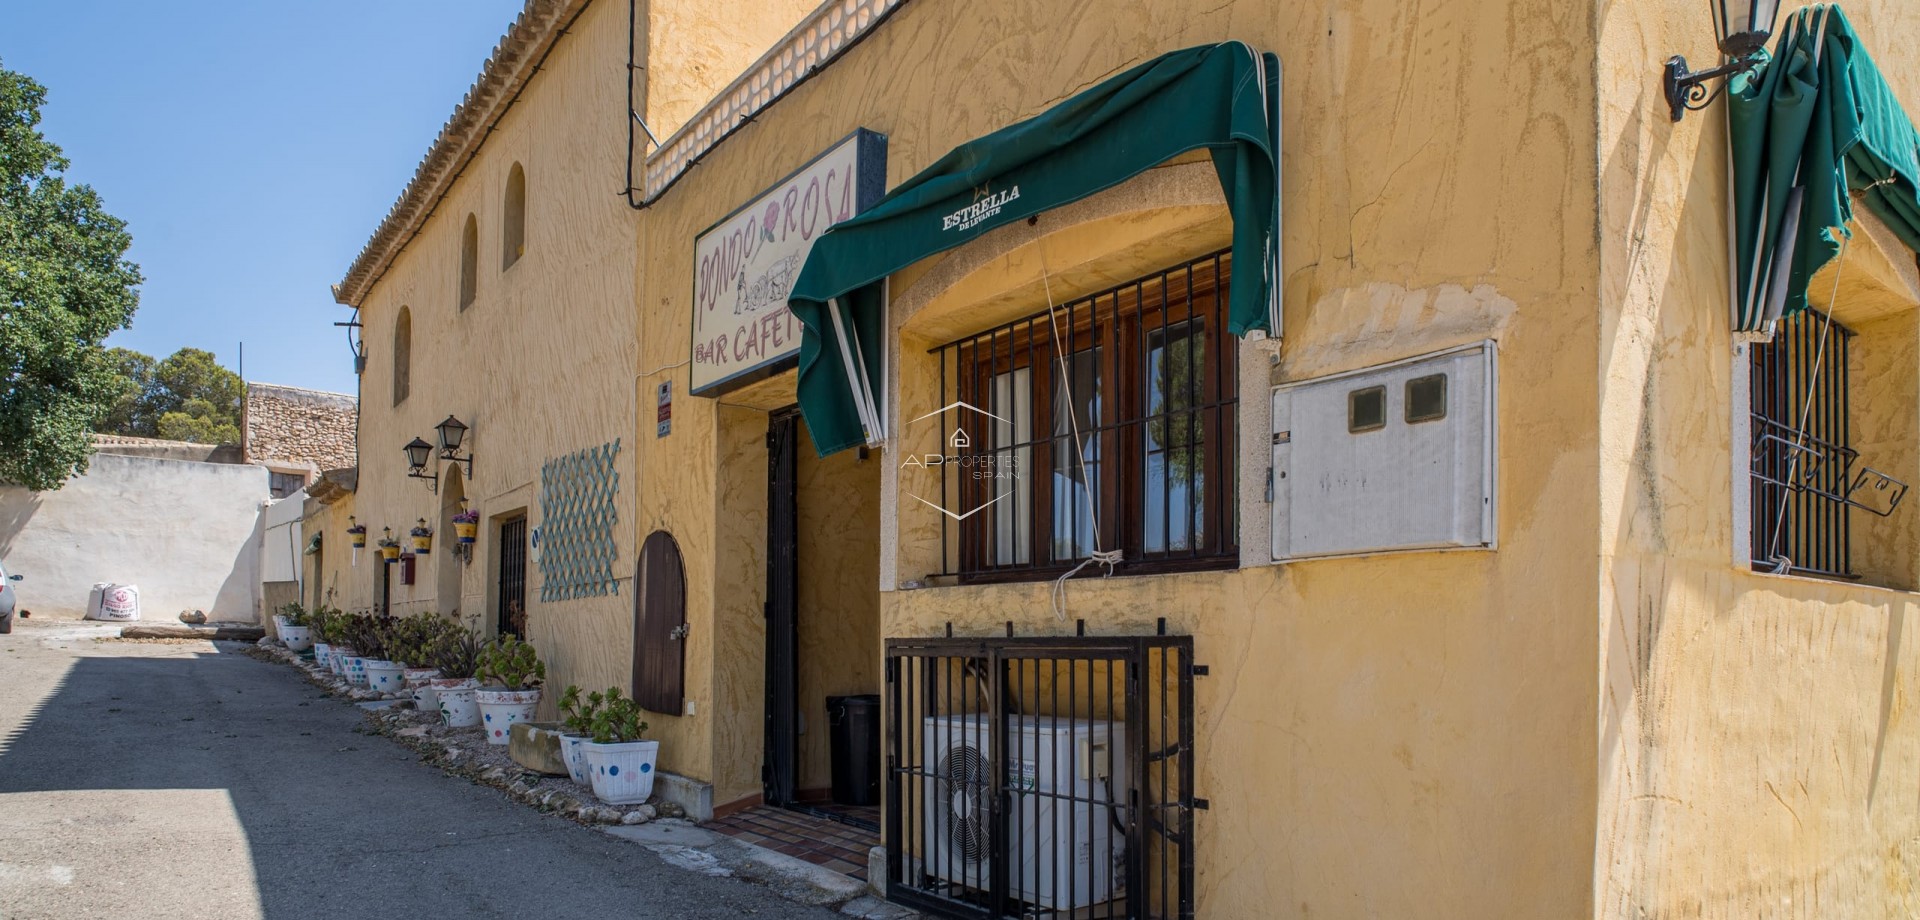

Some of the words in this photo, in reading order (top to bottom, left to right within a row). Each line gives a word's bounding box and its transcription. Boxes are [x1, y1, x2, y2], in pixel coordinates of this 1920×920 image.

[942, 185, 1020, 231] ESTRELLA
[958, 221, 970, 232] DE
[970, 206, 1001, 227] LEVANTE
[698, 214, 756, 333] PONDO
[782, 162, 852, 243] ROSA
[695, 333, 728, 366] BAR
